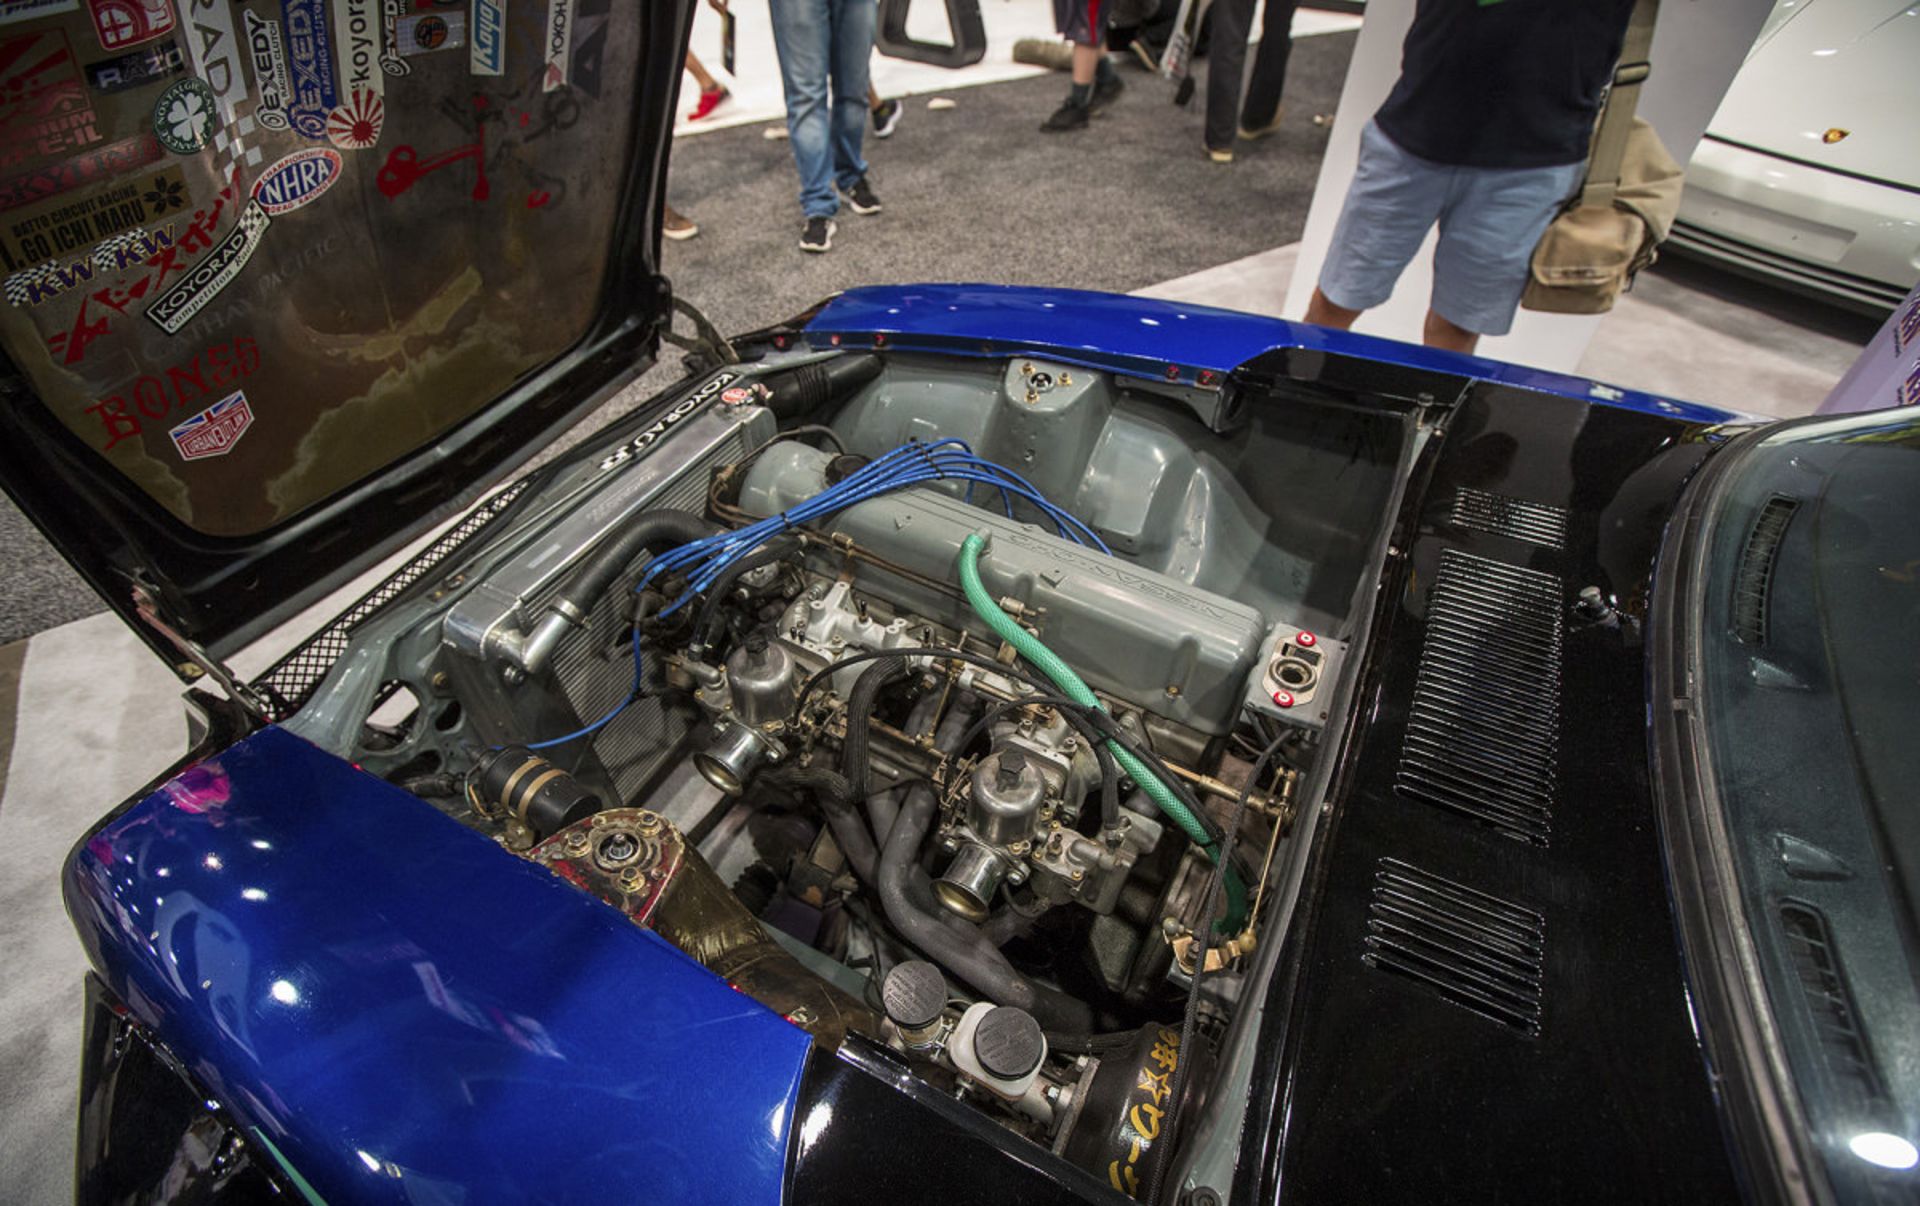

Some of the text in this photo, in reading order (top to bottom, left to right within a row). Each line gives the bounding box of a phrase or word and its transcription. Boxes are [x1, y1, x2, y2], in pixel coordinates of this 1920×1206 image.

[551, 0, 568, 57] YOKOH
[248, 16, 280, 111] EXEDY
[269, 22, 288, 98] RACING CLUTCH
[317, 49, 332, 96] RACING
[265, 159, 331, 204] NHRA
[51, 199, 97, 224] CIRCUIT
[51, 218, 95, 253] ICHI
[94, 197, 146, 236] MARU
[114, 223, 175, 271] KW
[25, 255, 95, 306] KW
[156, 233, 246, 319] KOYORAD
[167, 269, 234, 330] Competition
[633, 373, 735, 449] KOYORAD
